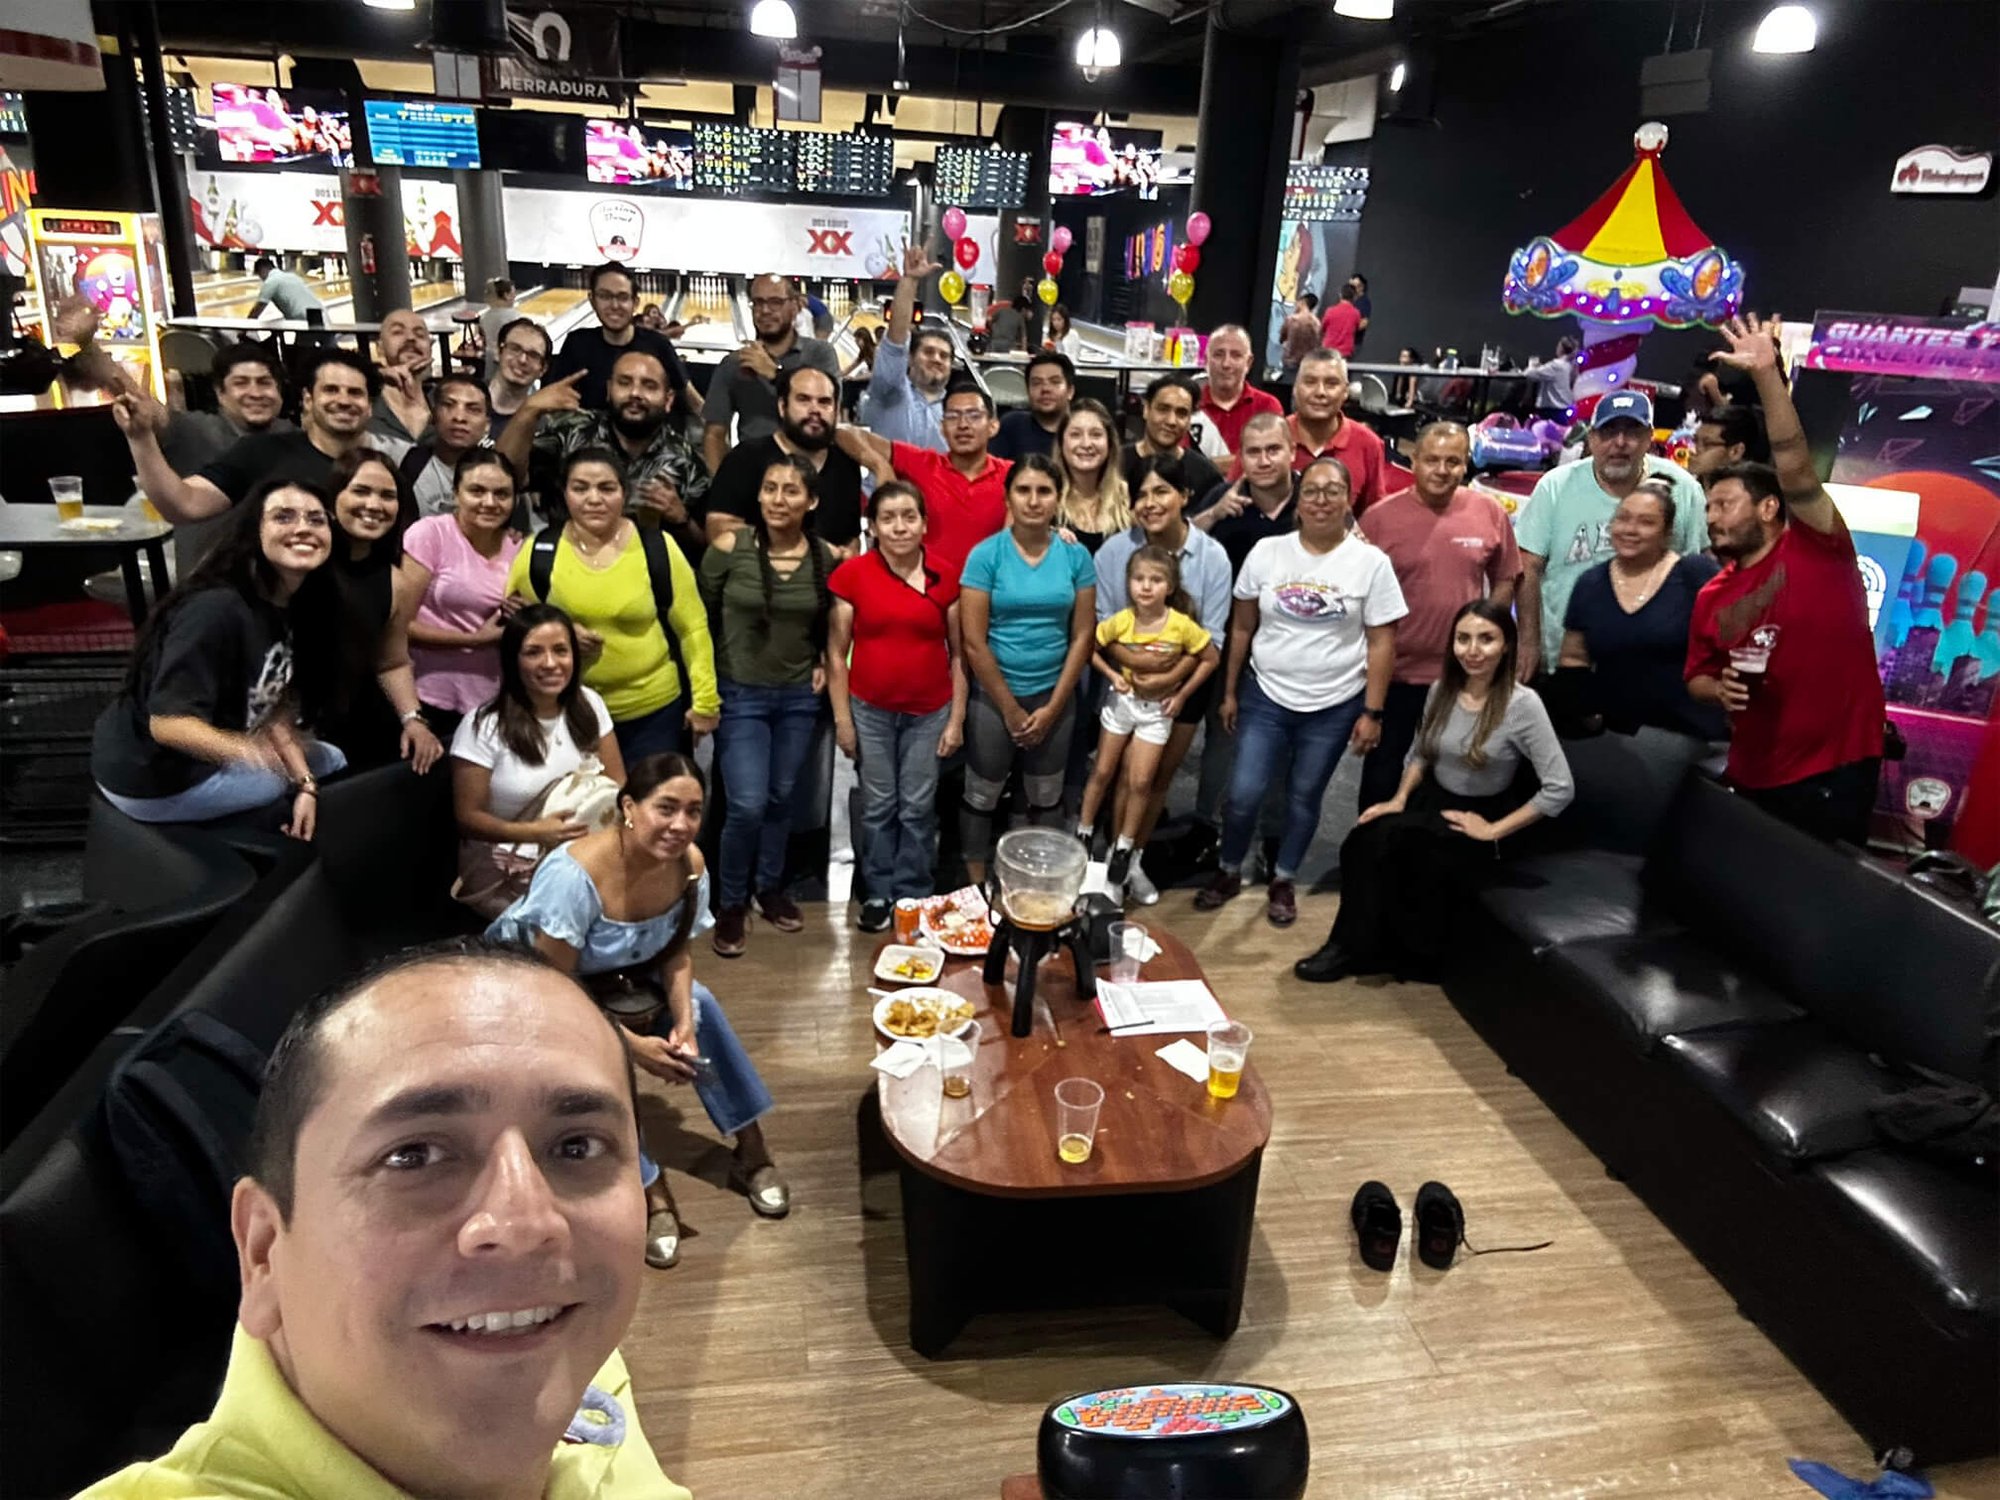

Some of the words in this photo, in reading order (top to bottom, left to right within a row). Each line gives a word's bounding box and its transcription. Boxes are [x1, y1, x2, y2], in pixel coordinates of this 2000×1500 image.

[500, 77, 609, 98] HERRADURA
[806, 229, 854, 256] XX
[1828, 322, 1971, 349] GUANTES
